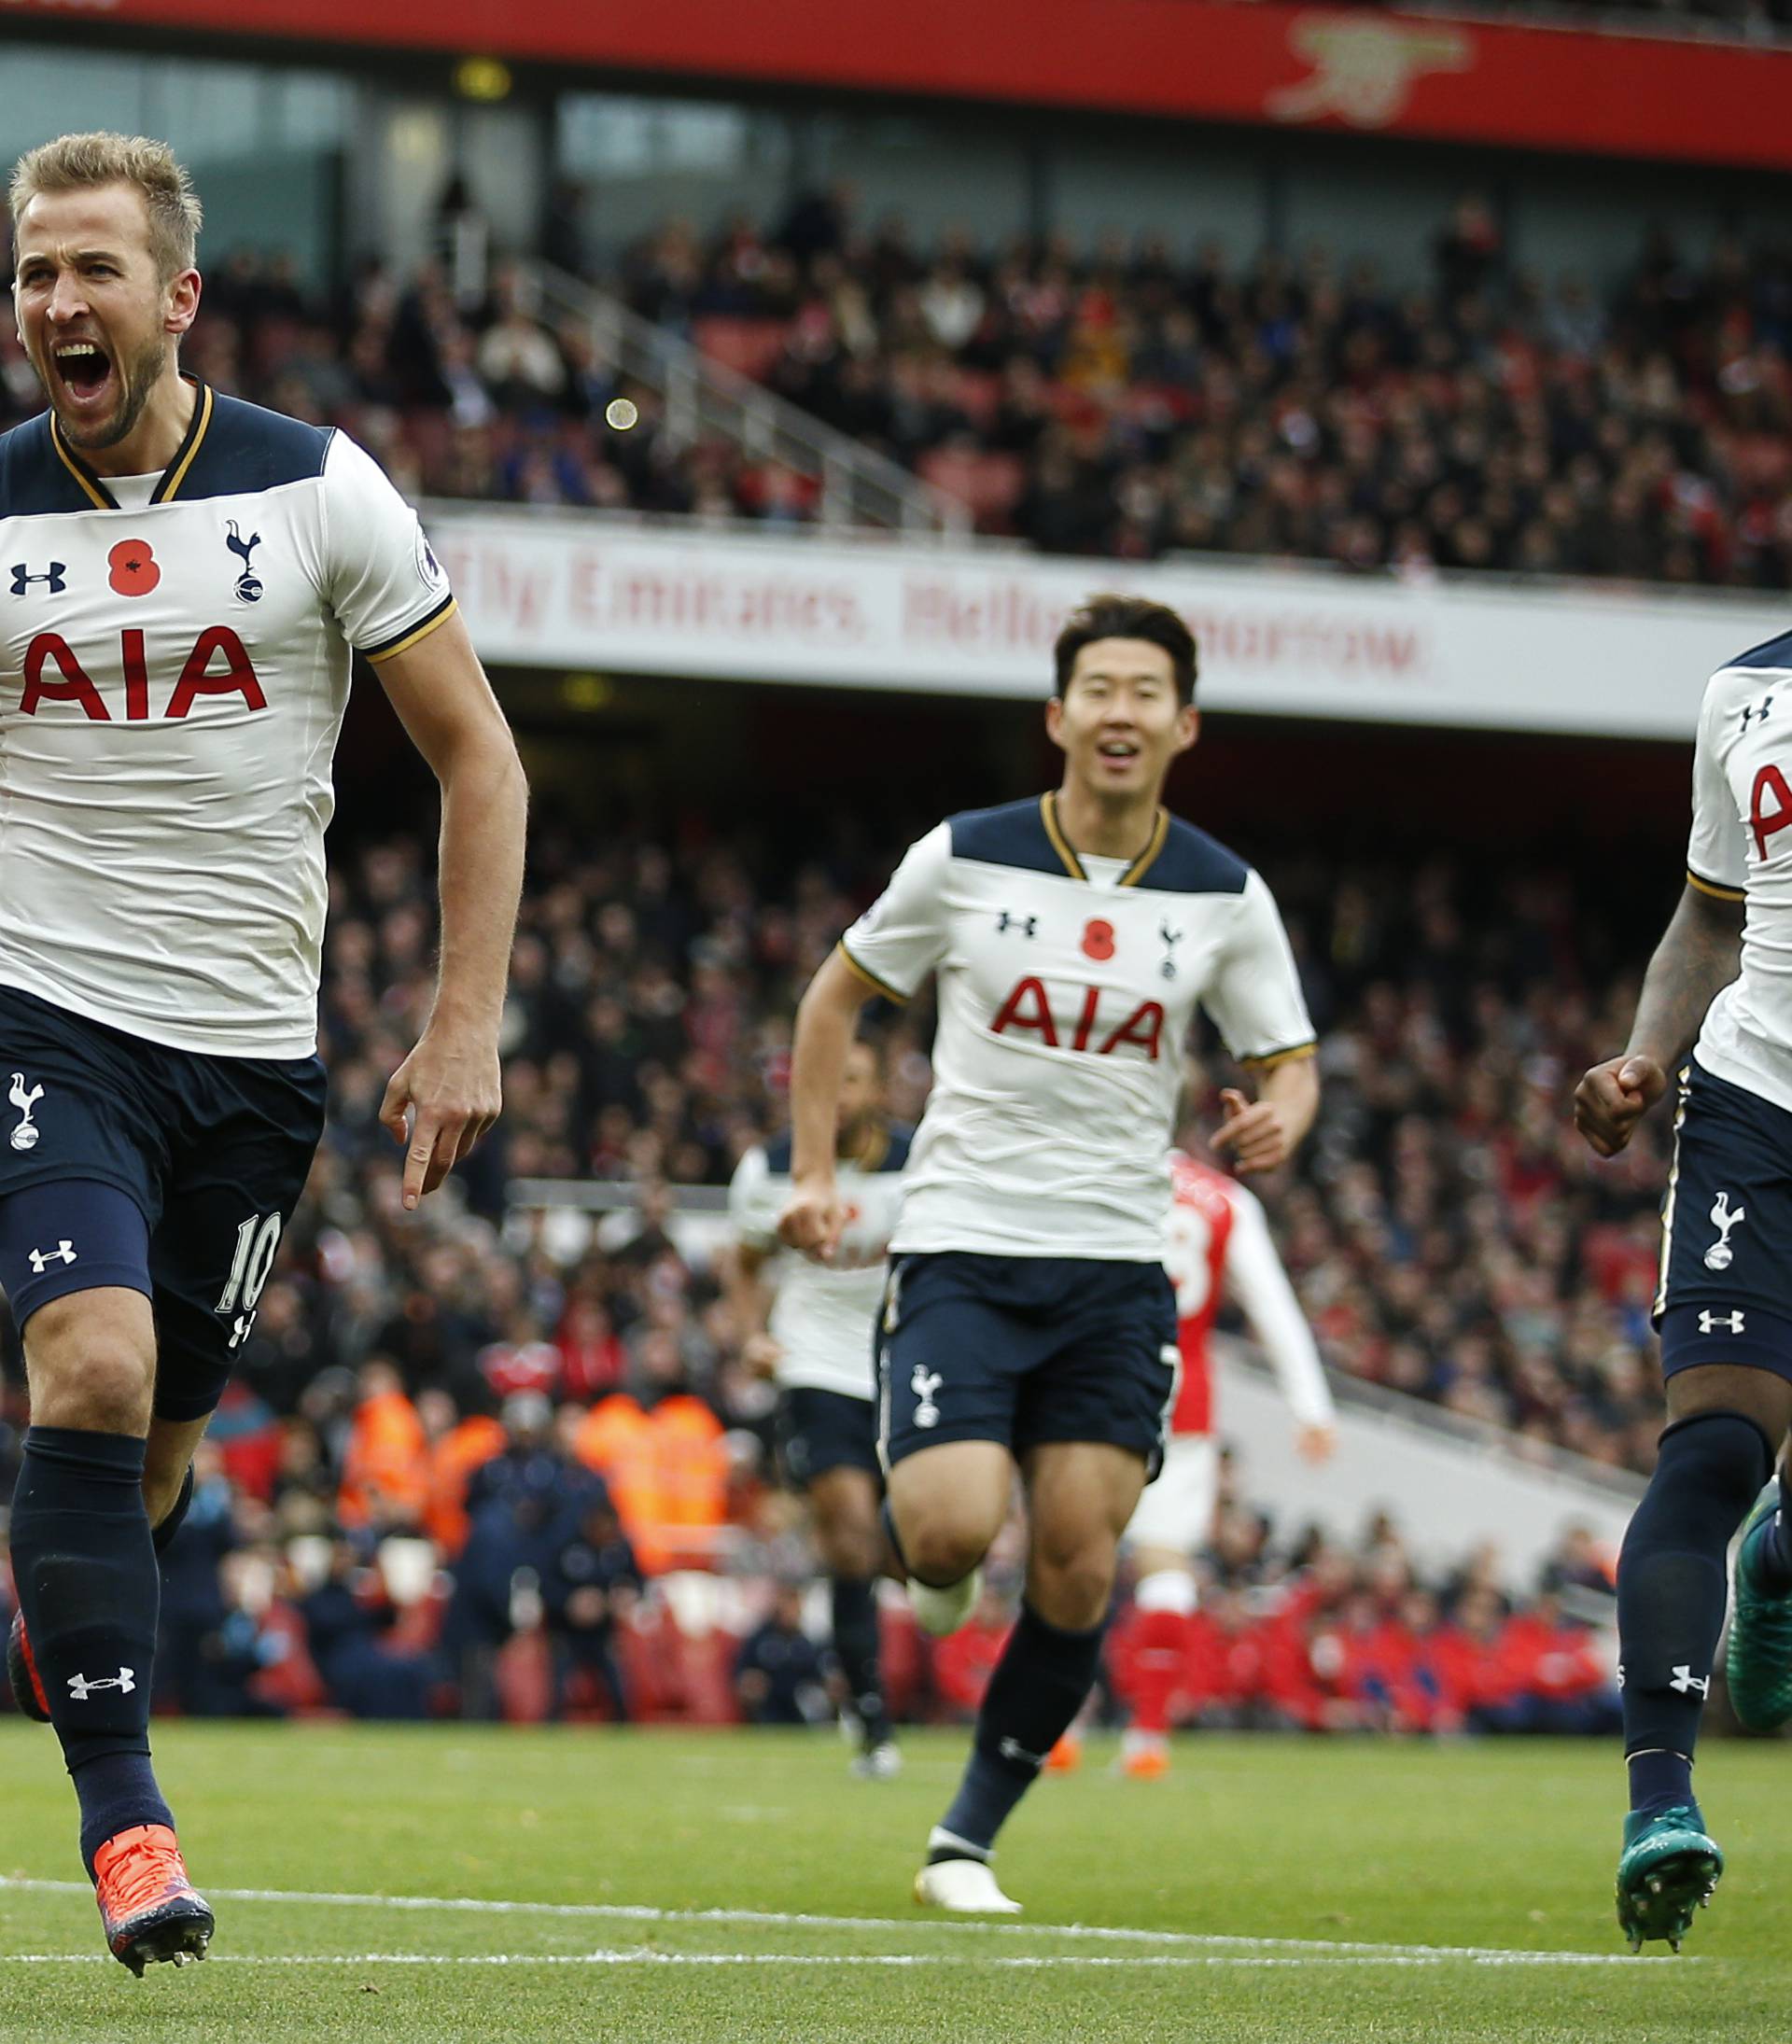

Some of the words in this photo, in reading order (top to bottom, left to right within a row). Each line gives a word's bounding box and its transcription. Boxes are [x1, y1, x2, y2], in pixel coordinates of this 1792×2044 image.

[19, 625, 268, 721] AIA
[990, 976, 1164, 1060] AIA
[214, 1211, 281, 1313] 10
